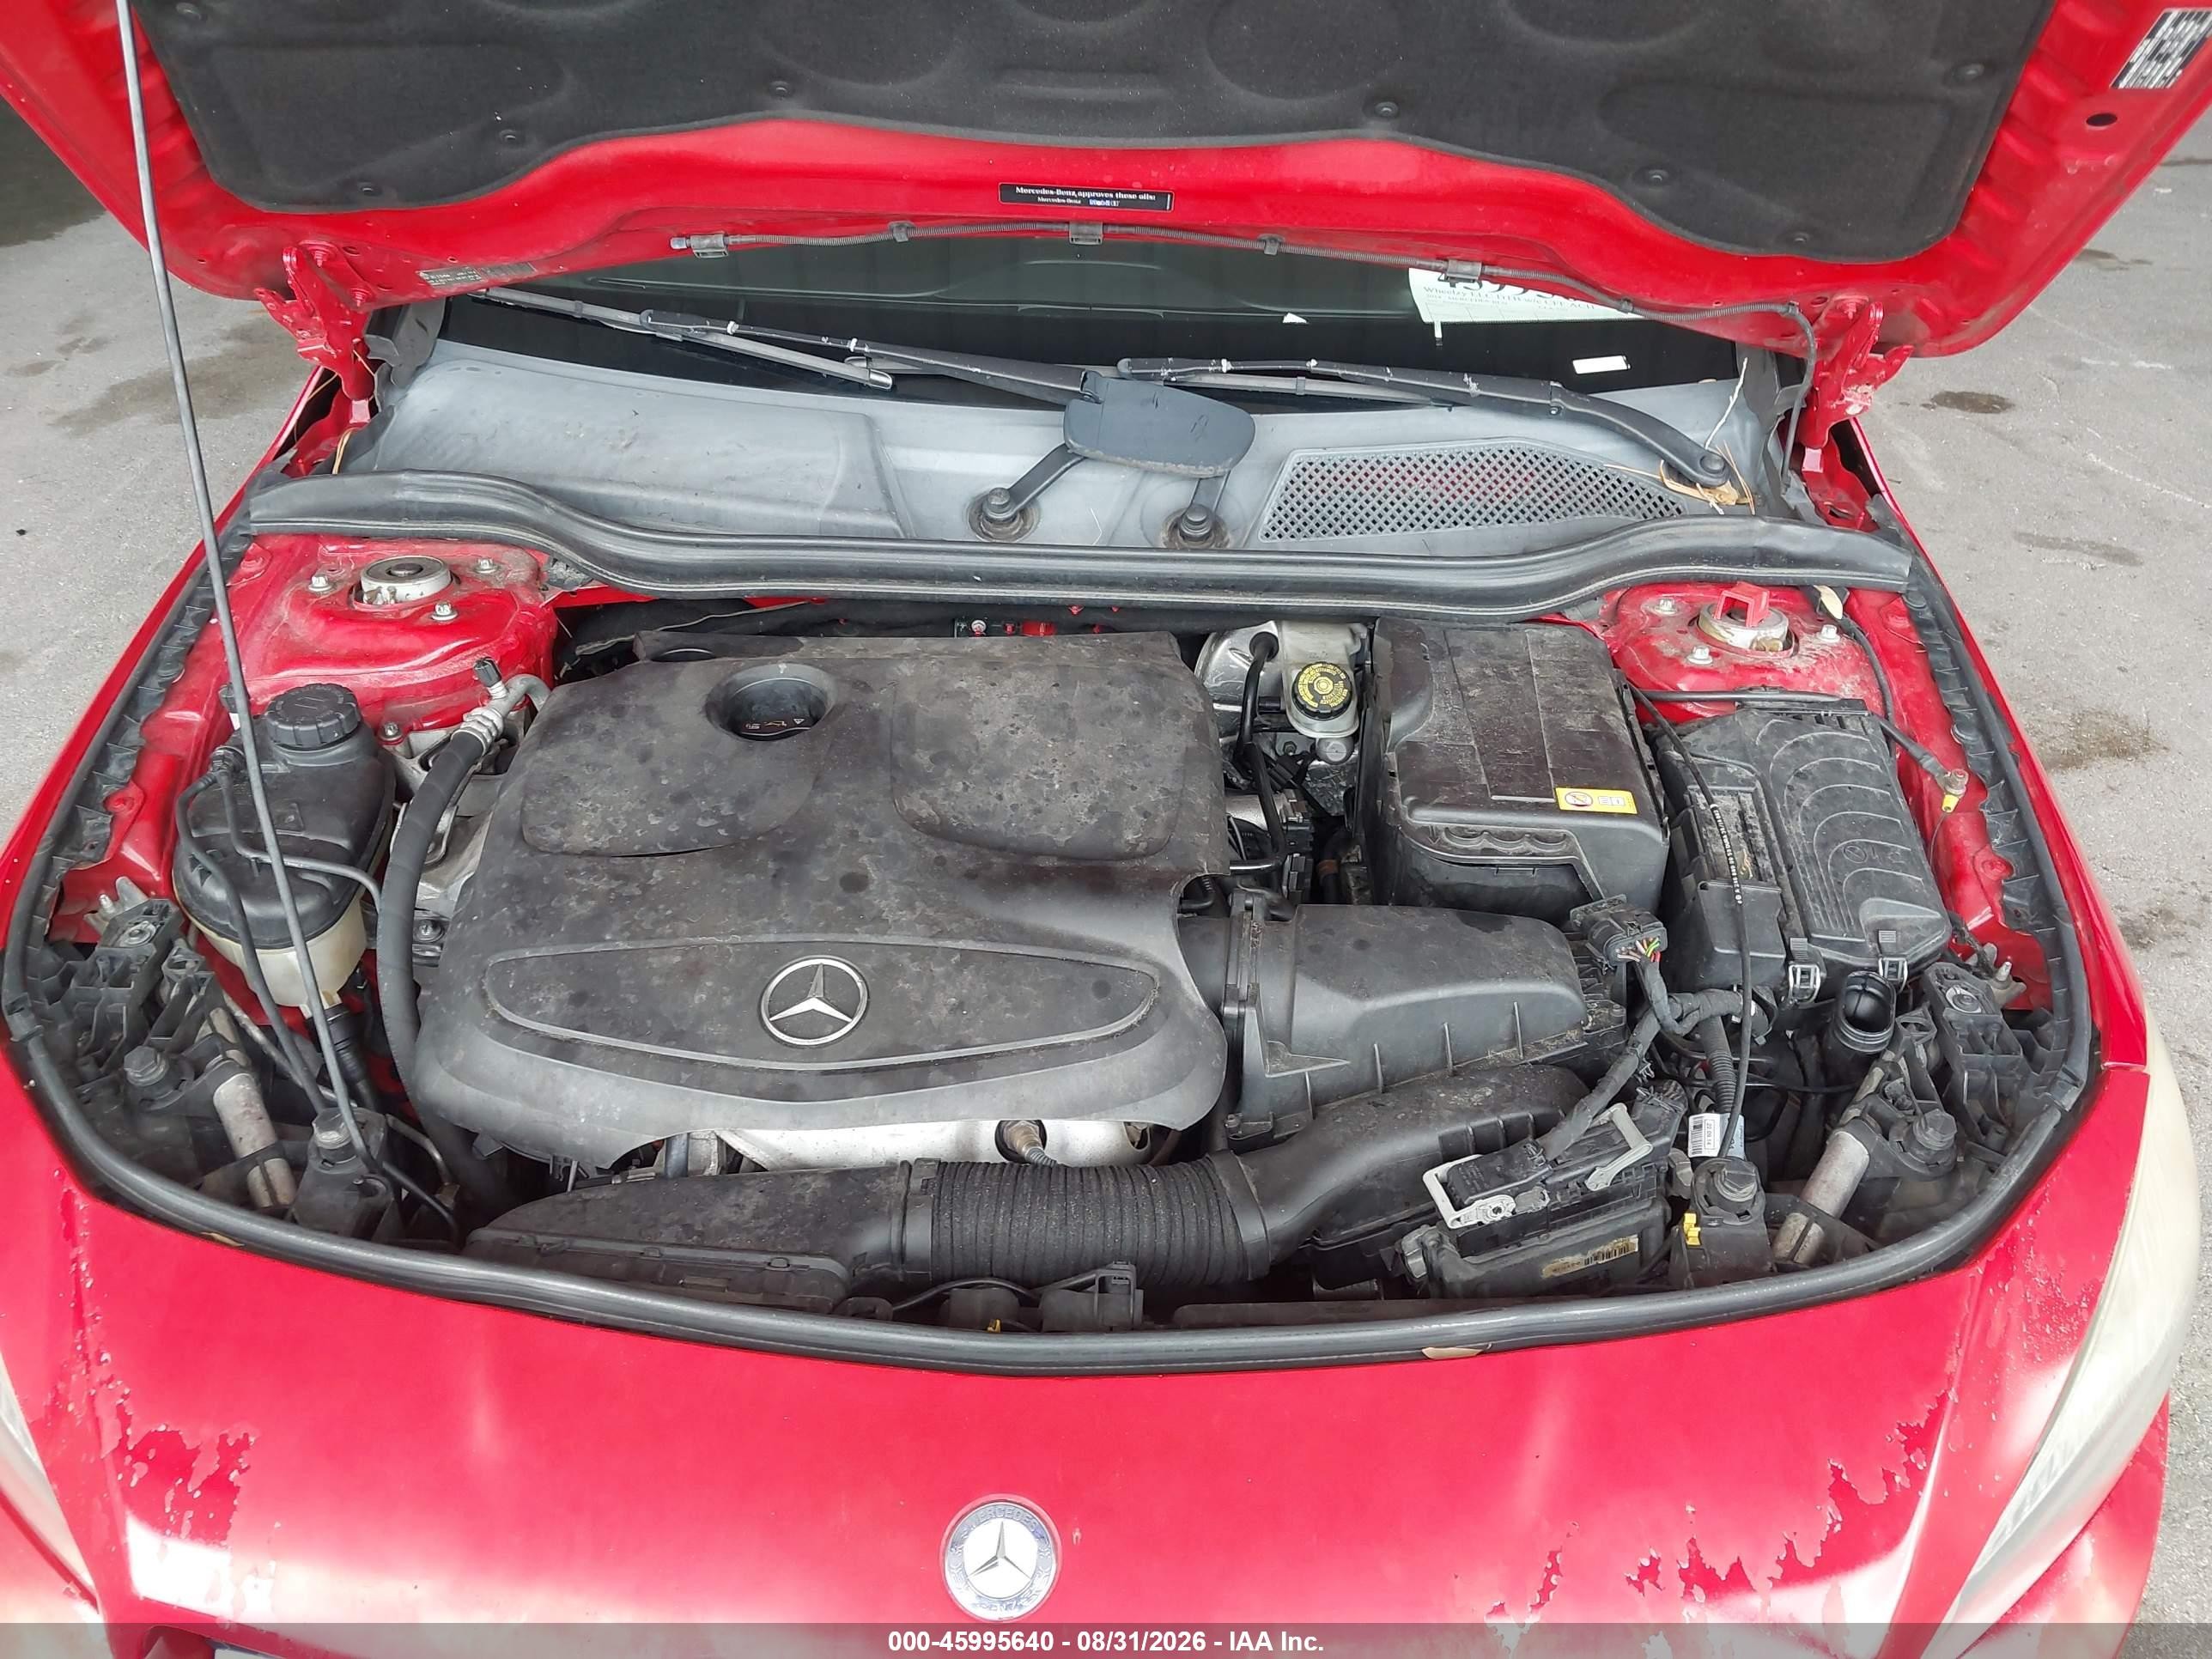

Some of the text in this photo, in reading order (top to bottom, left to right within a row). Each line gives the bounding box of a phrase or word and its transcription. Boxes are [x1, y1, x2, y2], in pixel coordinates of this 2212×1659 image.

[1016, 186, 1078, 198] Mercedes-Benz
[1078, 190, 1114, 198] approves
[1115, 191, 1137, 200] these
